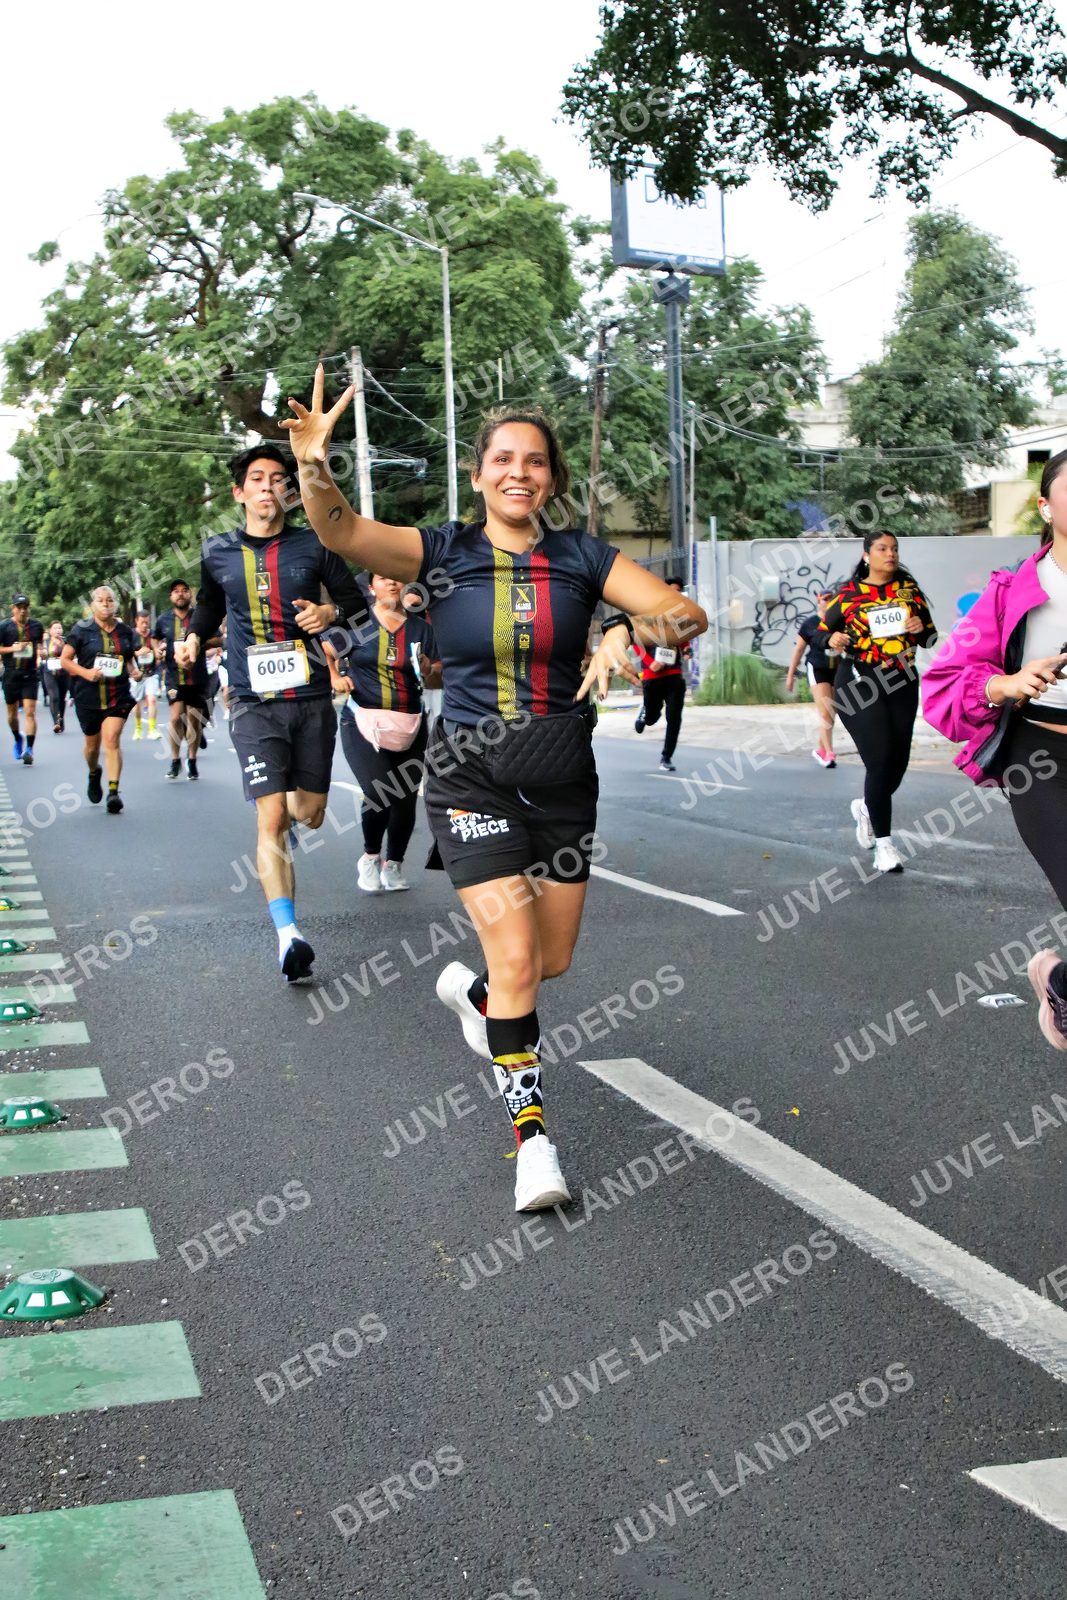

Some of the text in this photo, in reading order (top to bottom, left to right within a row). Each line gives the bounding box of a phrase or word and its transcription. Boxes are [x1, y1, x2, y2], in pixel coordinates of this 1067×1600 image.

[874, 611, 902, 625] 4560
[257, 656, 296, 676] 6005
[461, 818, 510, 842] PIECE
